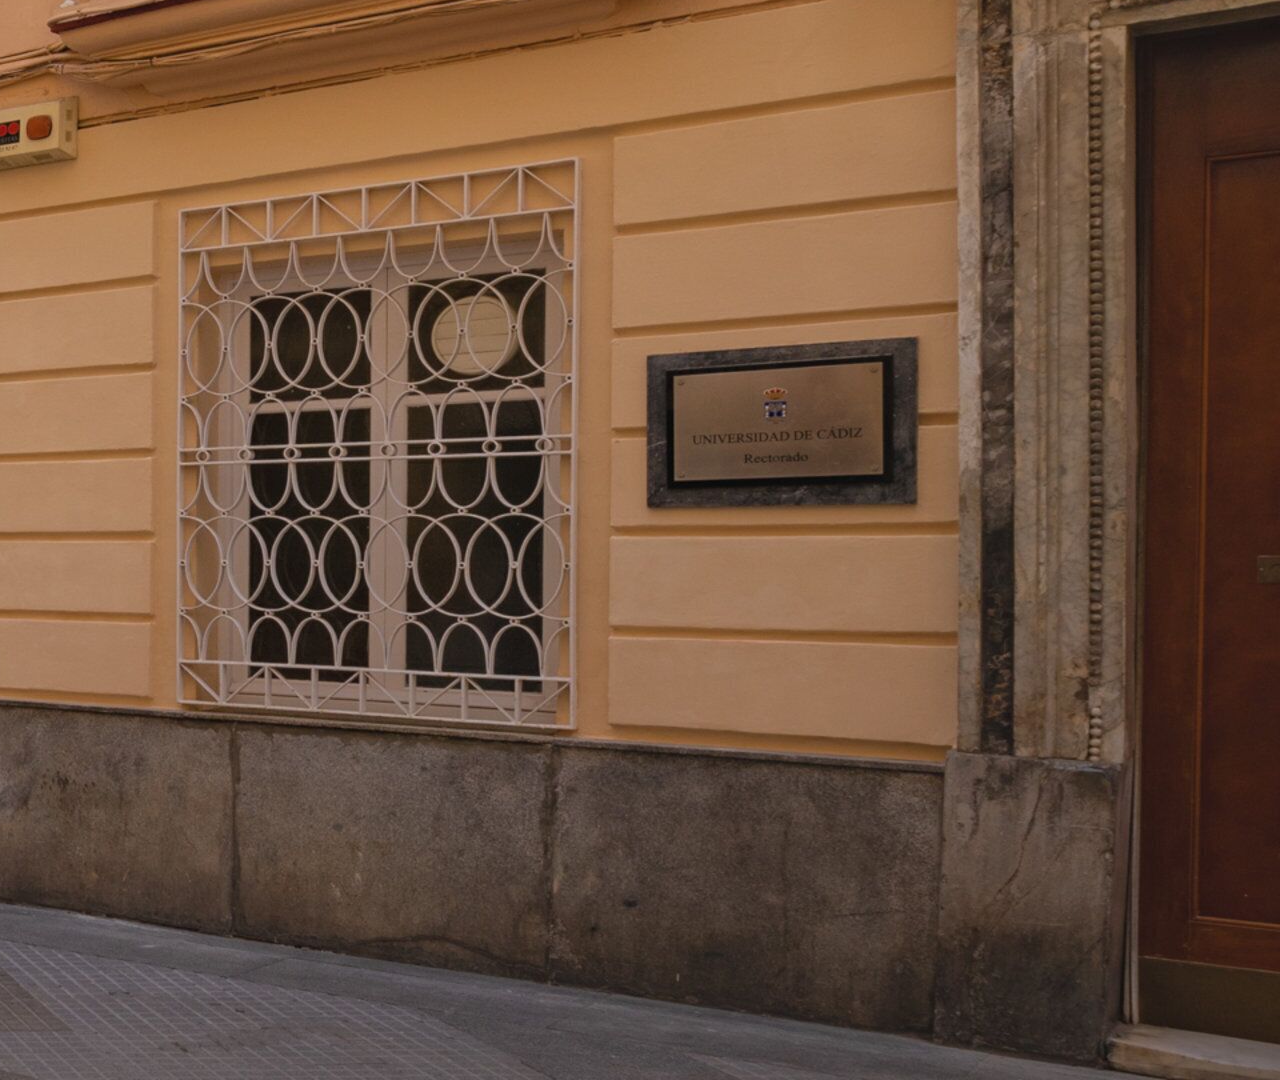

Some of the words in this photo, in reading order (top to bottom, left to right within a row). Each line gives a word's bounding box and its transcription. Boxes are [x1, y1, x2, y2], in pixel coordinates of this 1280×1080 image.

[692, 430, 790, 445] UNIVERSIDAD
[793, 429, 814, 441] DE
[816, 426, 864, 439] CÁDIZ
[744, 451, 809, 464] Rectorado
